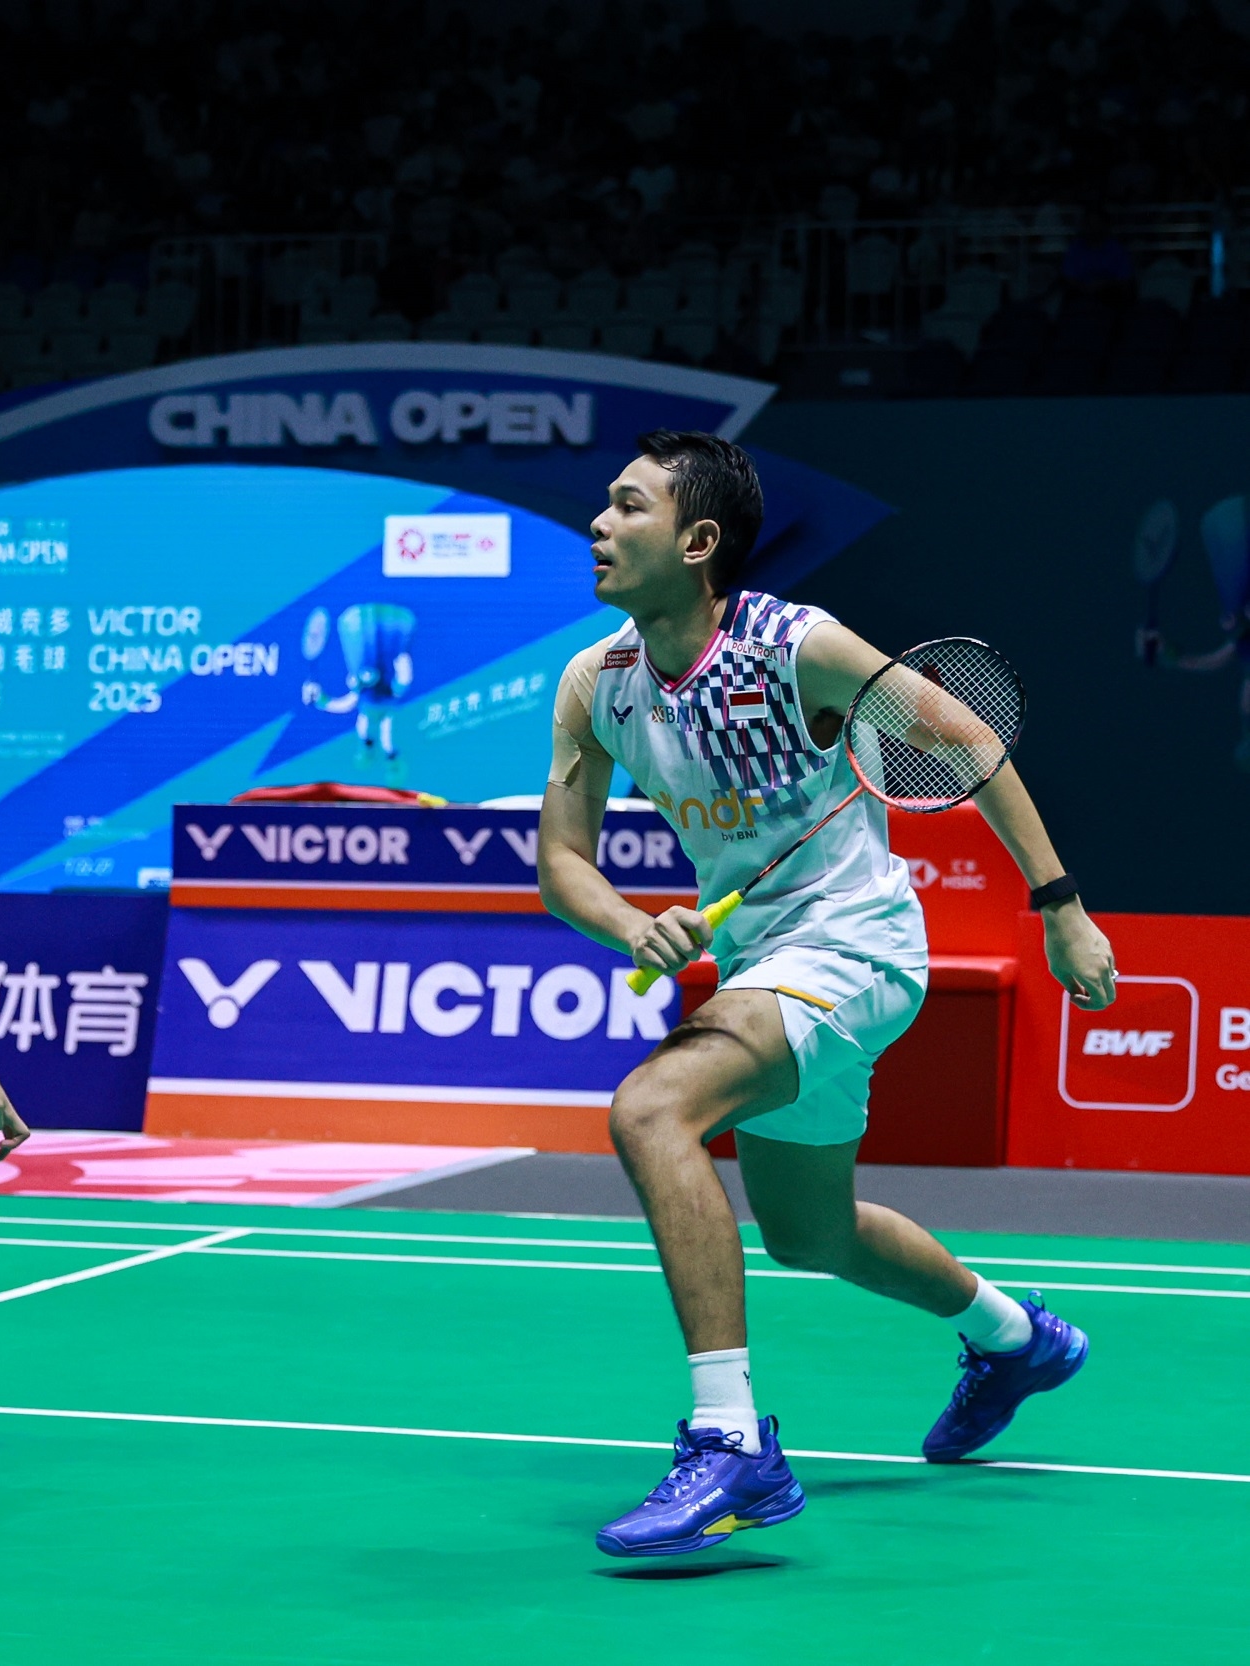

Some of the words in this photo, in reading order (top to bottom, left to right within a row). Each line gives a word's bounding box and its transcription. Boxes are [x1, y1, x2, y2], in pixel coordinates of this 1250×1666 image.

[150, 391, 378, 447] CHINA
[390, 391, 593, 445] OPEN
[88, 606, 202, 637] VICTOR
[88, 643, 184, 675] CHINA
[190, 642, 280, 677] OPEN
[606, 652, 628, 661] Kapal
[607, 659, 628, 667] Group
[88, 682, 162, 713] 2025
[666, 706, 696, 724] BNI
[651, 787, 764, 830] vndr
[241, 824, 410, 866] VICTOR
[500, 828, 675, 869] VOR
[721, 832, 735, 843] by
[736, 830, 758, 841] BNI
[299, 961, 676, 1041] VICTOR
[1083, 1029, 1175, 1057] BWF
